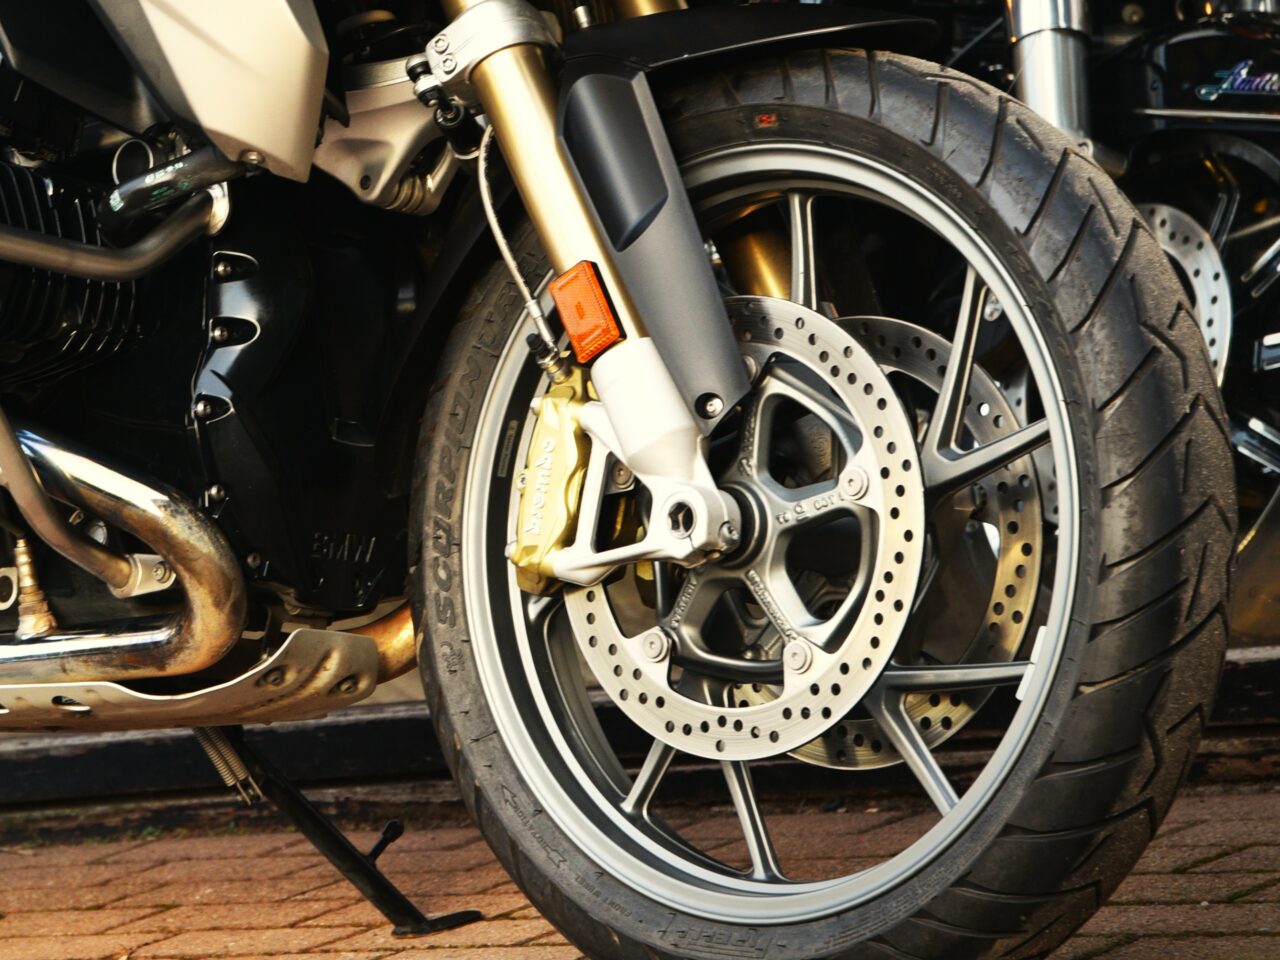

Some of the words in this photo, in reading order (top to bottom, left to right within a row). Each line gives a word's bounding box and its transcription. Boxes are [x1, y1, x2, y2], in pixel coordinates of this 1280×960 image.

[433, 353, 482, 630] SCORPION
[311, 532, 377, 563] BMW
[510, 803, 549, 850] ROTATION
[601, 894, 632, 918] FRONT
